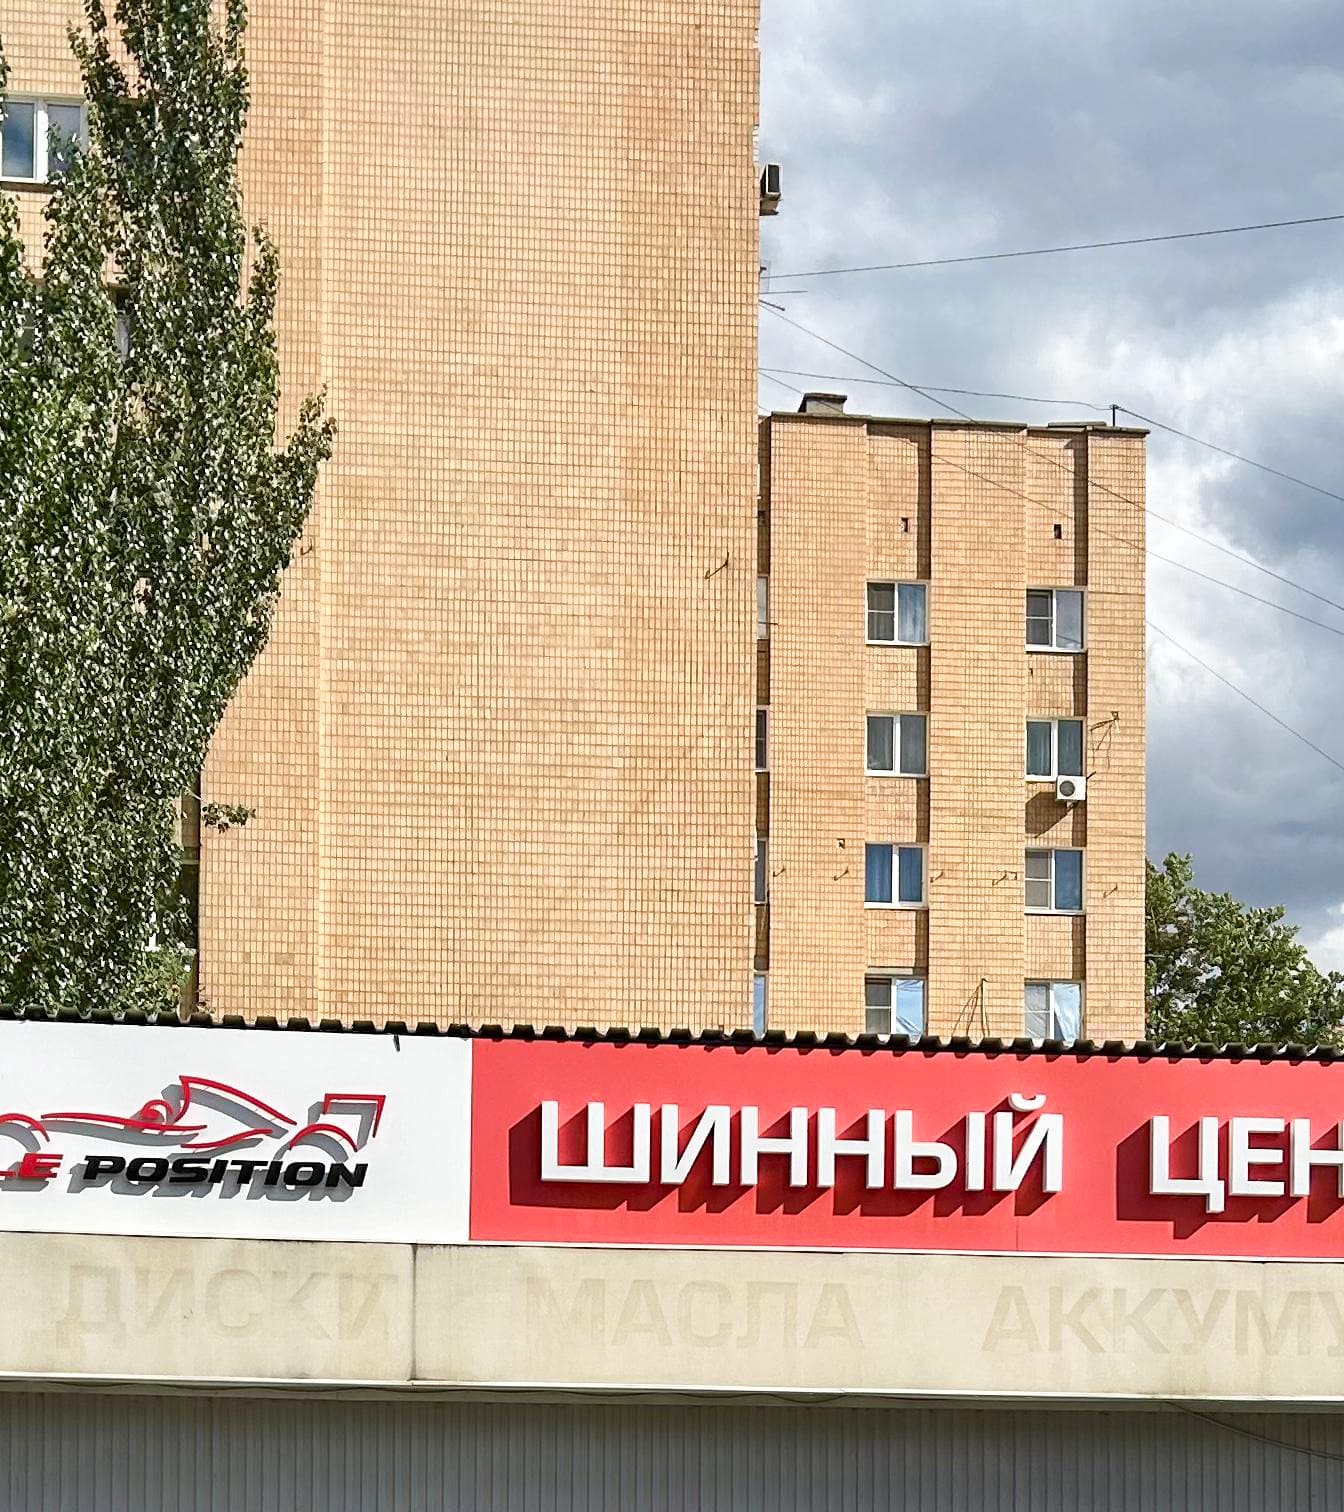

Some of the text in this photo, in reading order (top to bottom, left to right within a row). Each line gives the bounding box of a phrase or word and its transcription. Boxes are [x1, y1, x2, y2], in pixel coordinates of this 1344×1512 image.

[83, 1154, 369, 1188] POSITION
[540, 1092, 1064, 1193] ШИННЫЙ
[55, 1263, 398, 1347] ДИСКИ
[523, 1277, 866, 1349] МАСЛА
